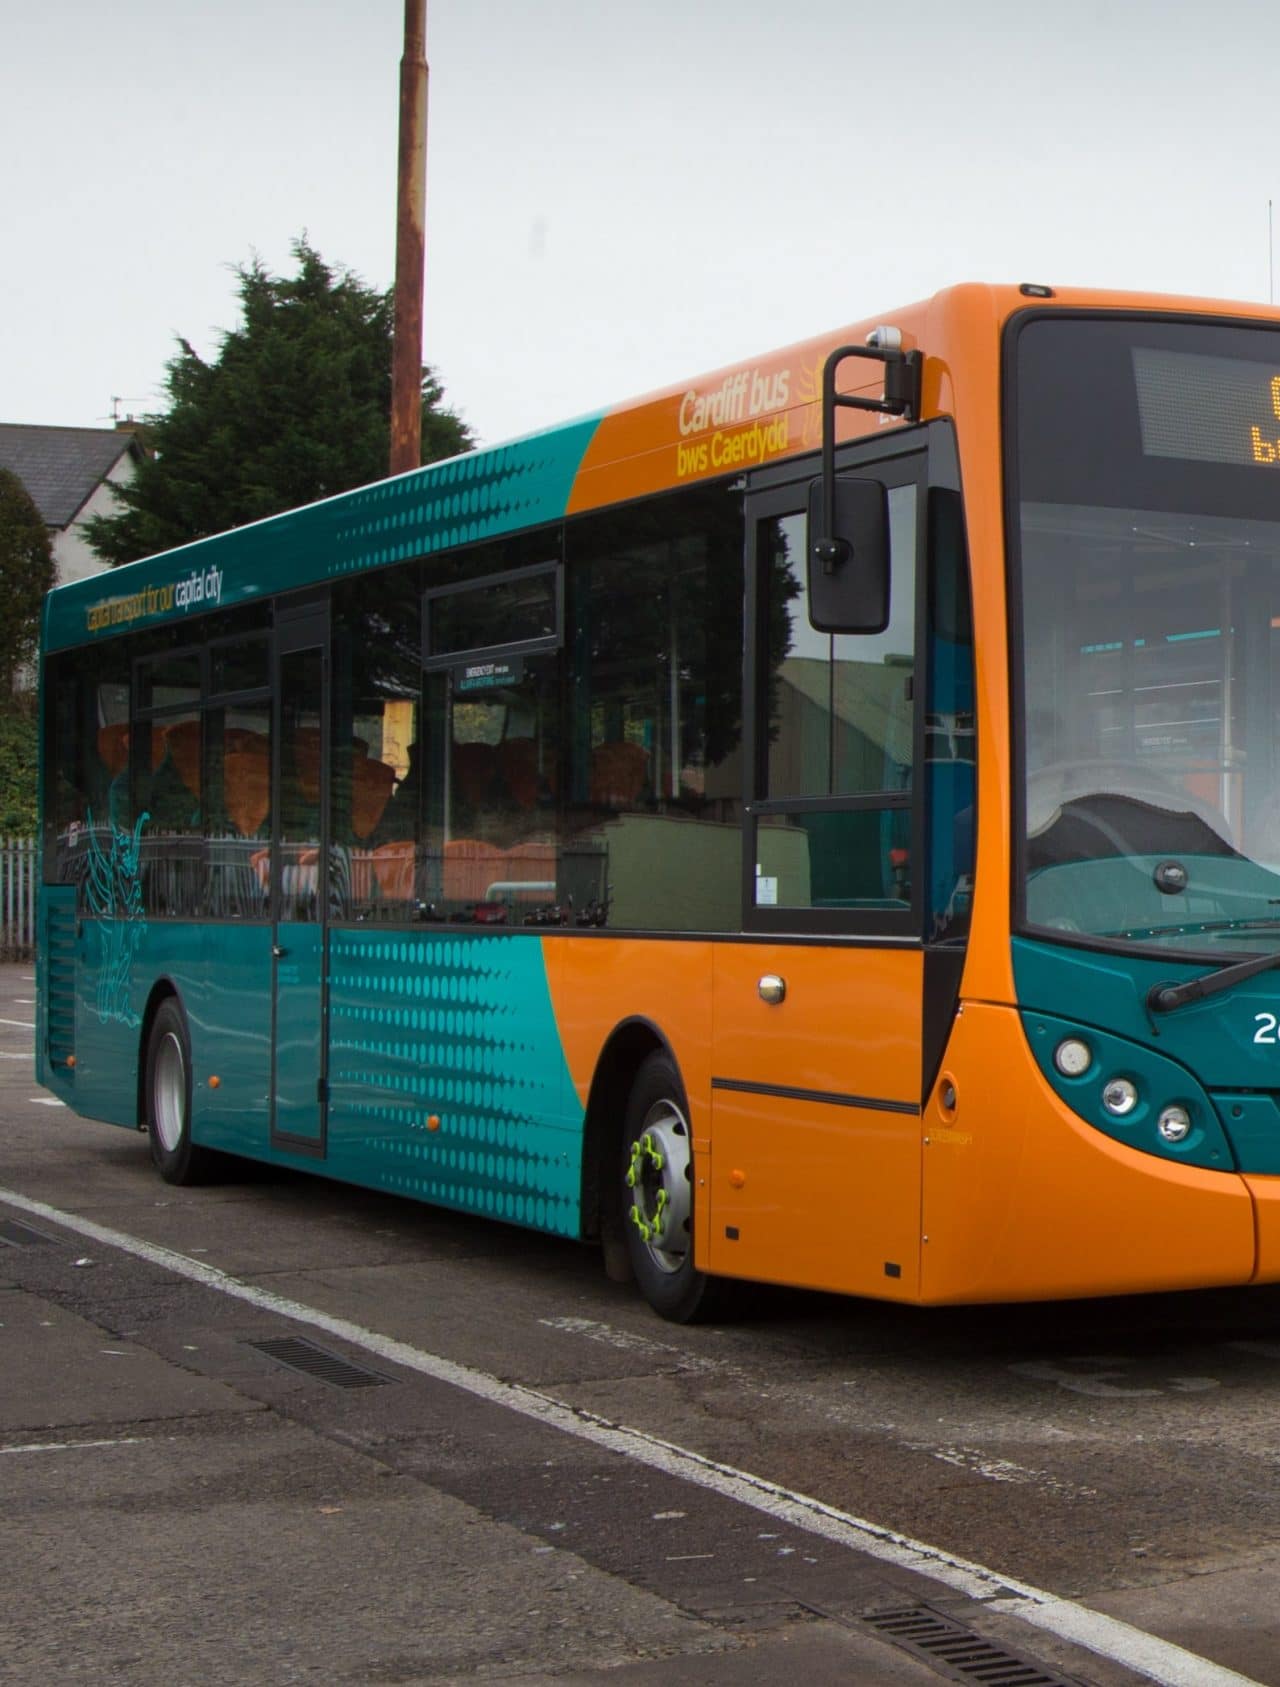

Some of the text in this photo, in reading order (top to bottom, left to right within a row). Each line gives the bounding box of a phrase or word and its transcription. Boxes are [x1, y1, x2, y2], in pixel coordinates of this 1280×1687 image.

[679, 368, 790, 436] Cardiff bus
[677, 411, 788, 478] bws Caerdydd
[175, 568, 205, 612] capital
[205, 565, 224, 604] city
